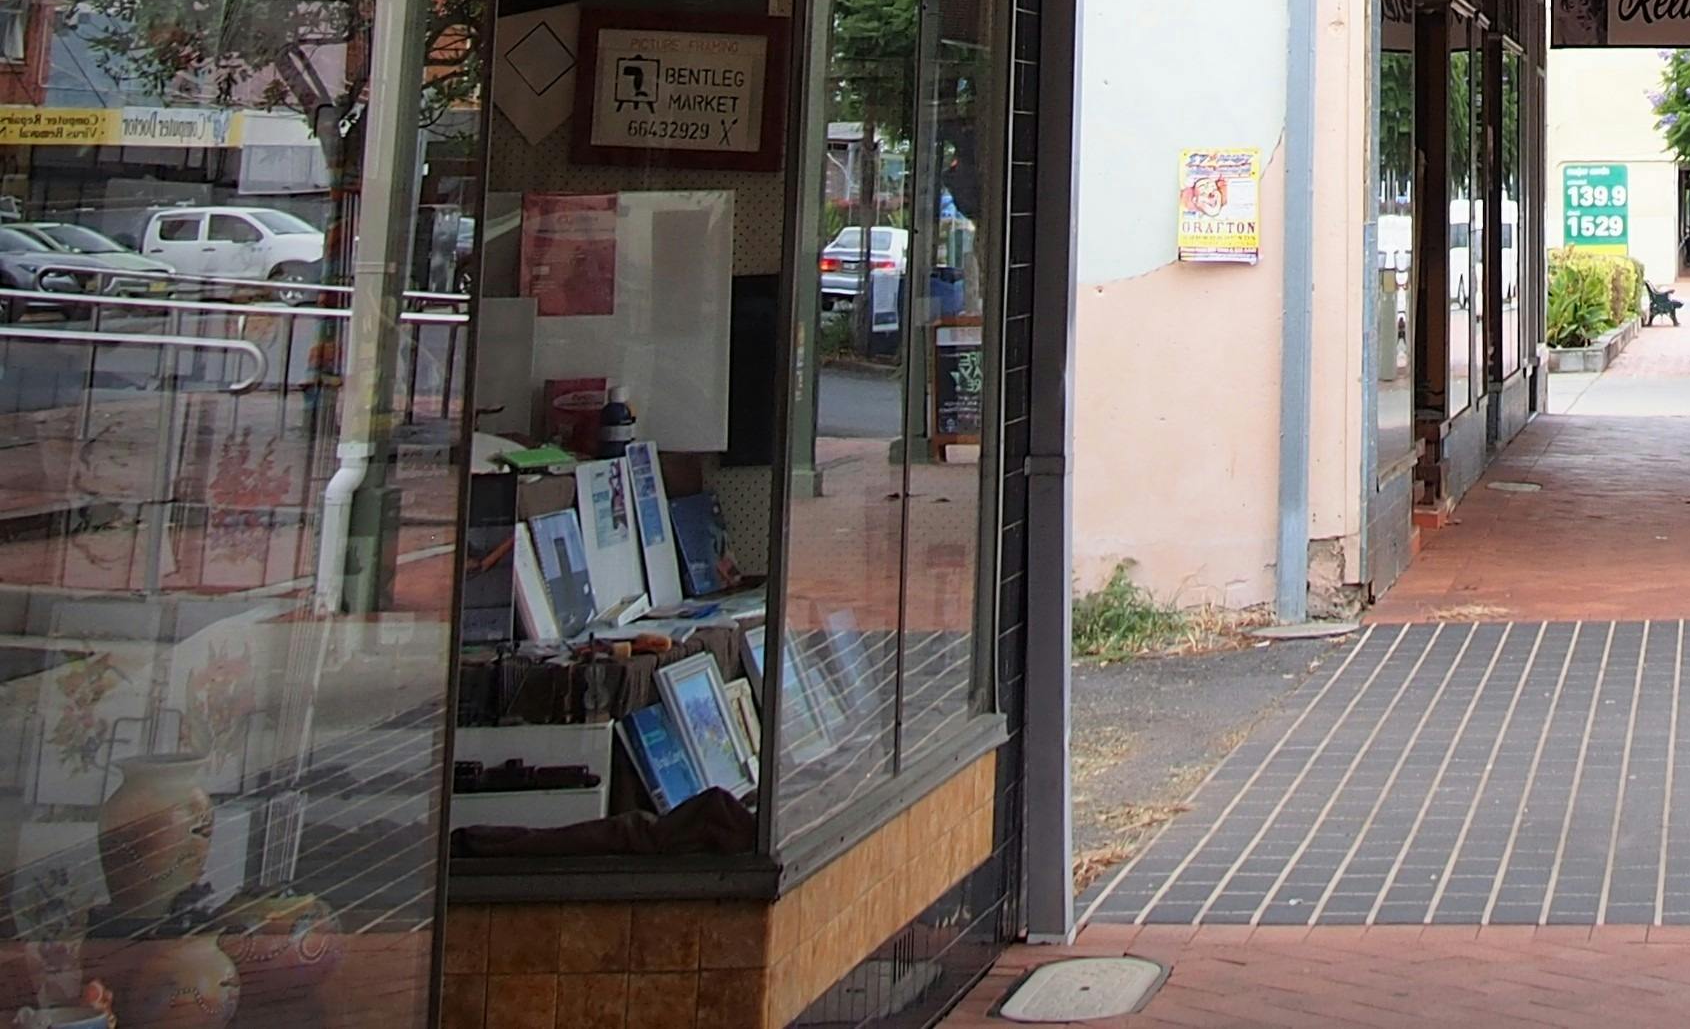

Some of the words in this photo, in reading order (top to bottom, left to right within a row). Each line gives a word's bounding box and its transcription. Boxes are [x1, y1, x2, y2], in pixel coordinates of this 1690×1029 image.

[630, 37, 680, 52] PICTURE
[688, 40, 739, 54] FRAMING
[665, 67, 745, 87] BENTLEG
[668, 94, 740, 113] MARKET
[627, 120, 710, 140] 66432929
